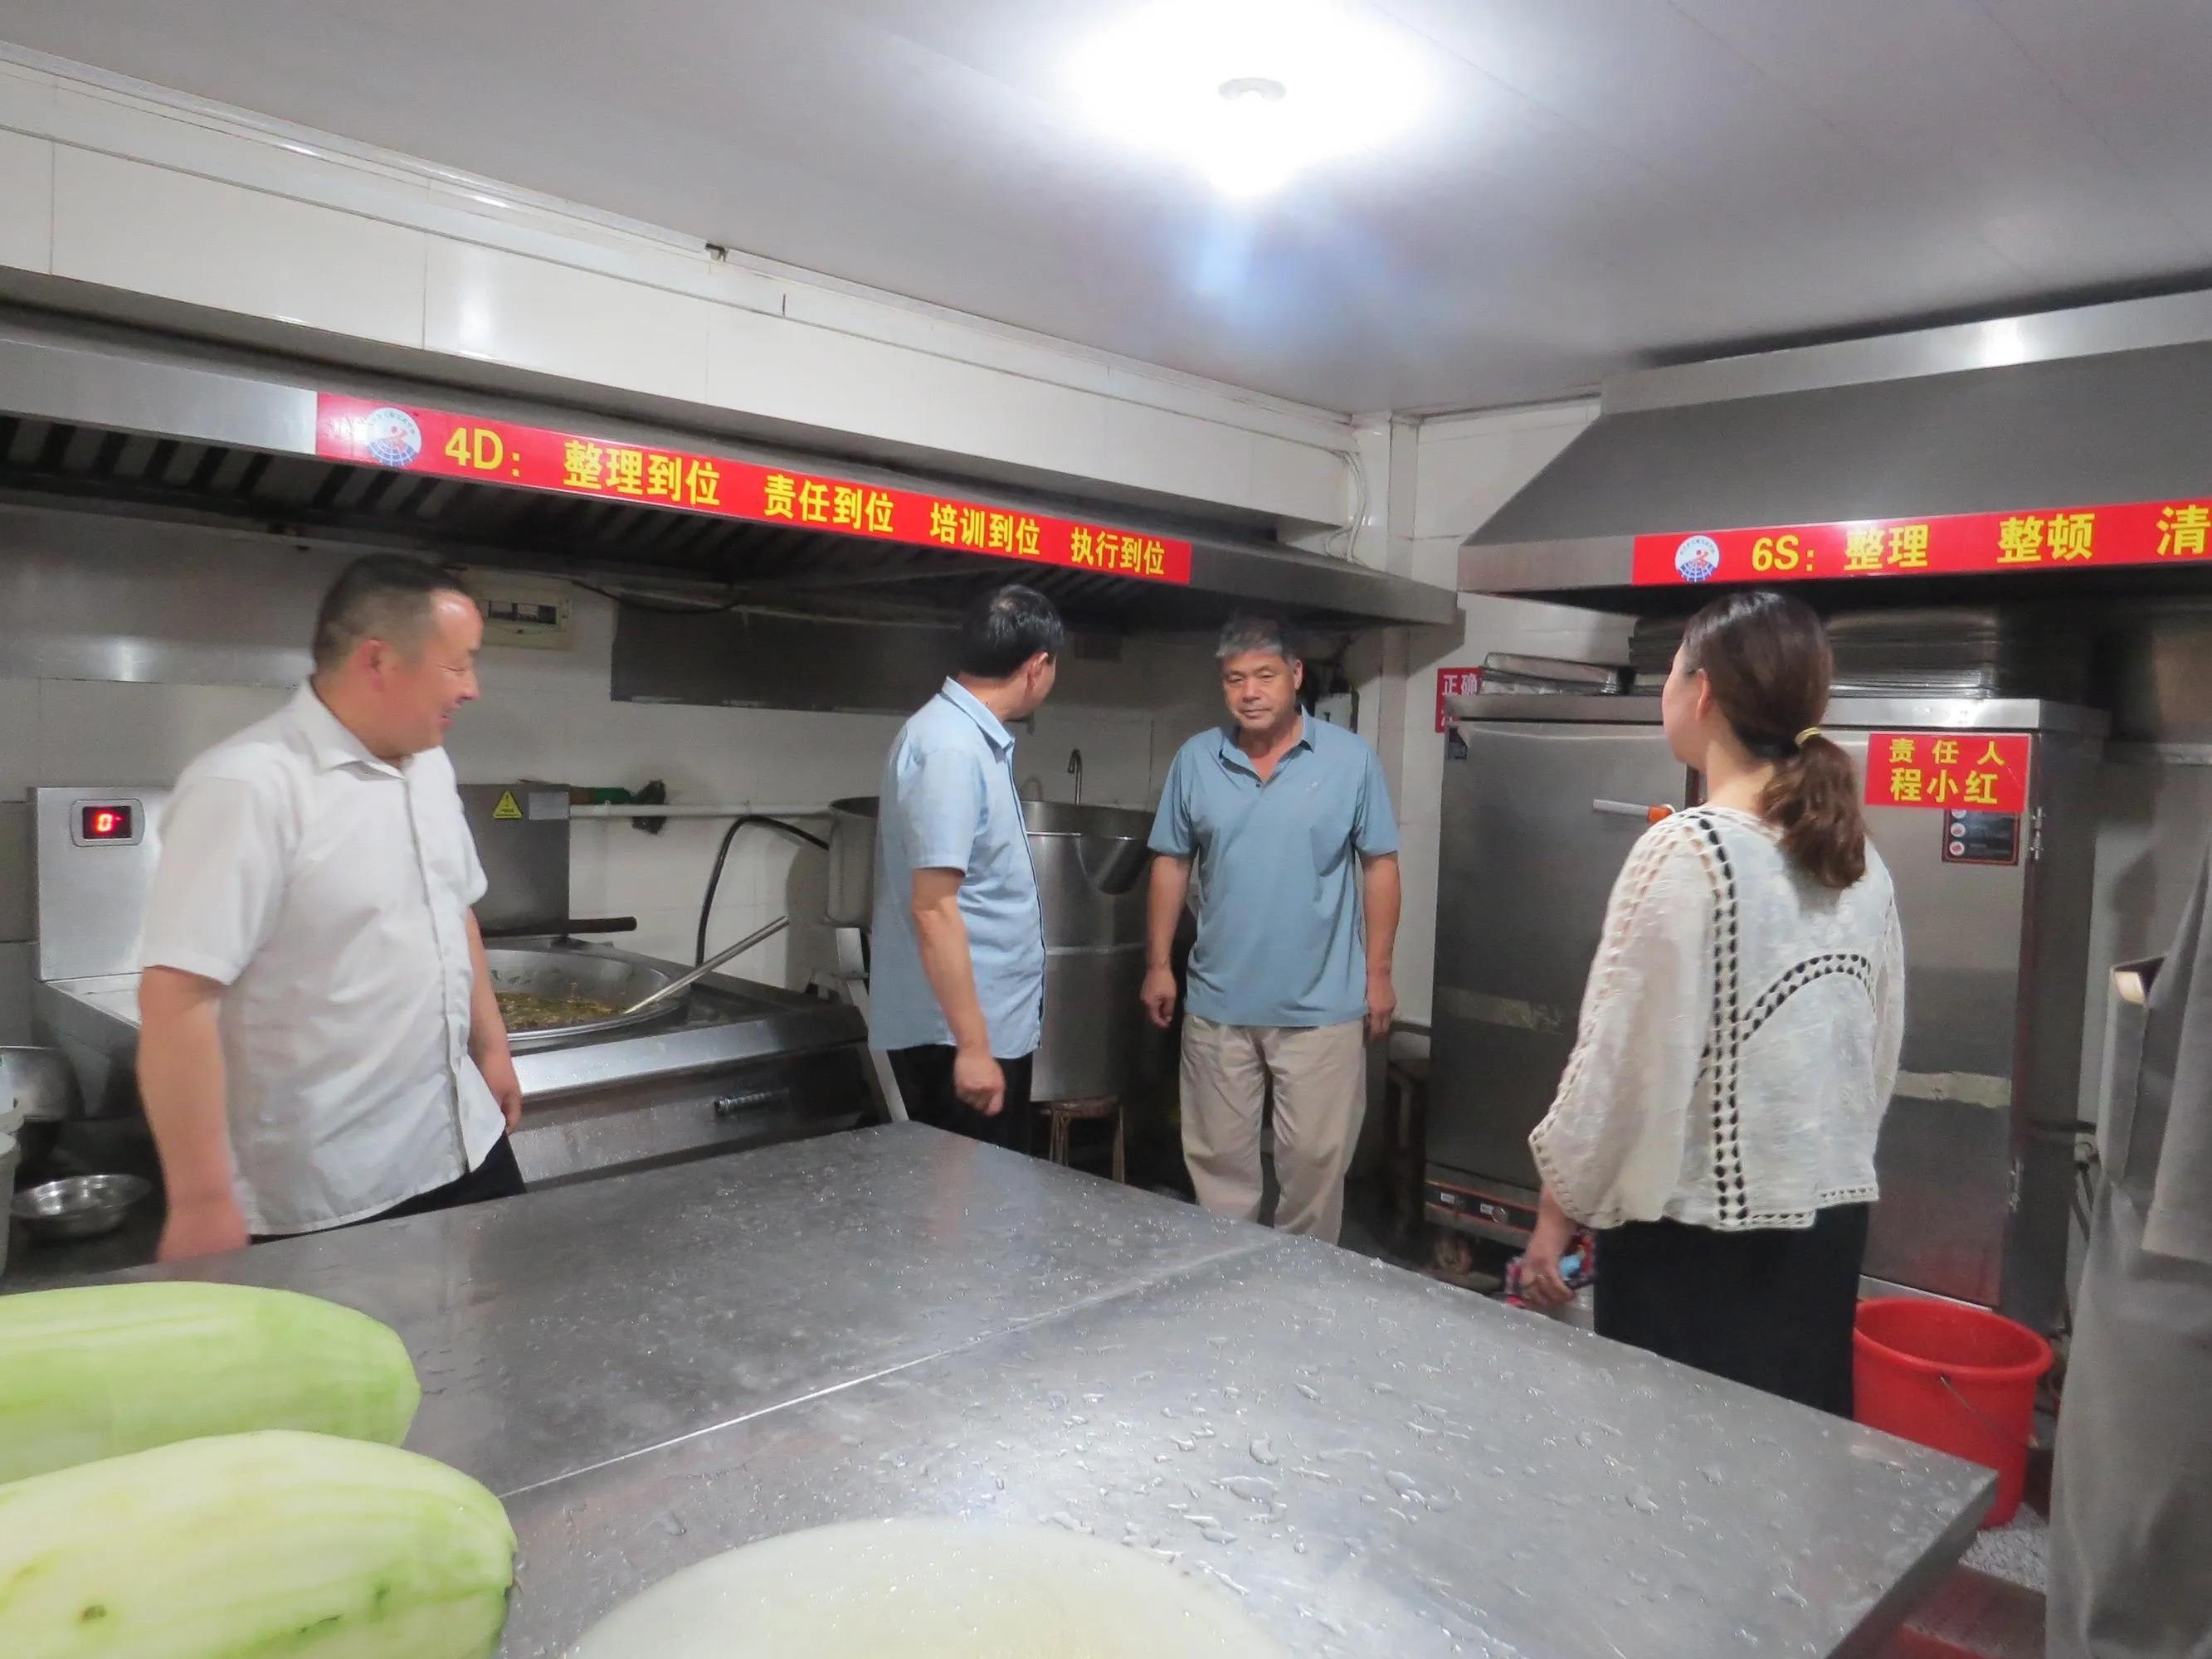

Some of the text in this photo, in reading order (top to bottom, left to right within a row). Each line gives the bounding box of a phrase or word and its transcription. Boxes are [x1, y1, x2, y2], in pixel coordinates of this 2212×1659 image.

[563, 440, 720, 506] 整理到位
[764, 474, 894, 533] 责任到位
[929, 502, 1040, 555] 培训到位
[1070, 527, 1165, 575] 执行到位
[1844, 524, 1929, 571] 整理
[1996, 513, 2096, 563] 整顿
[2156, 504, 2211, 555] 清
[1889, 767, 1998, 804] 程小红
